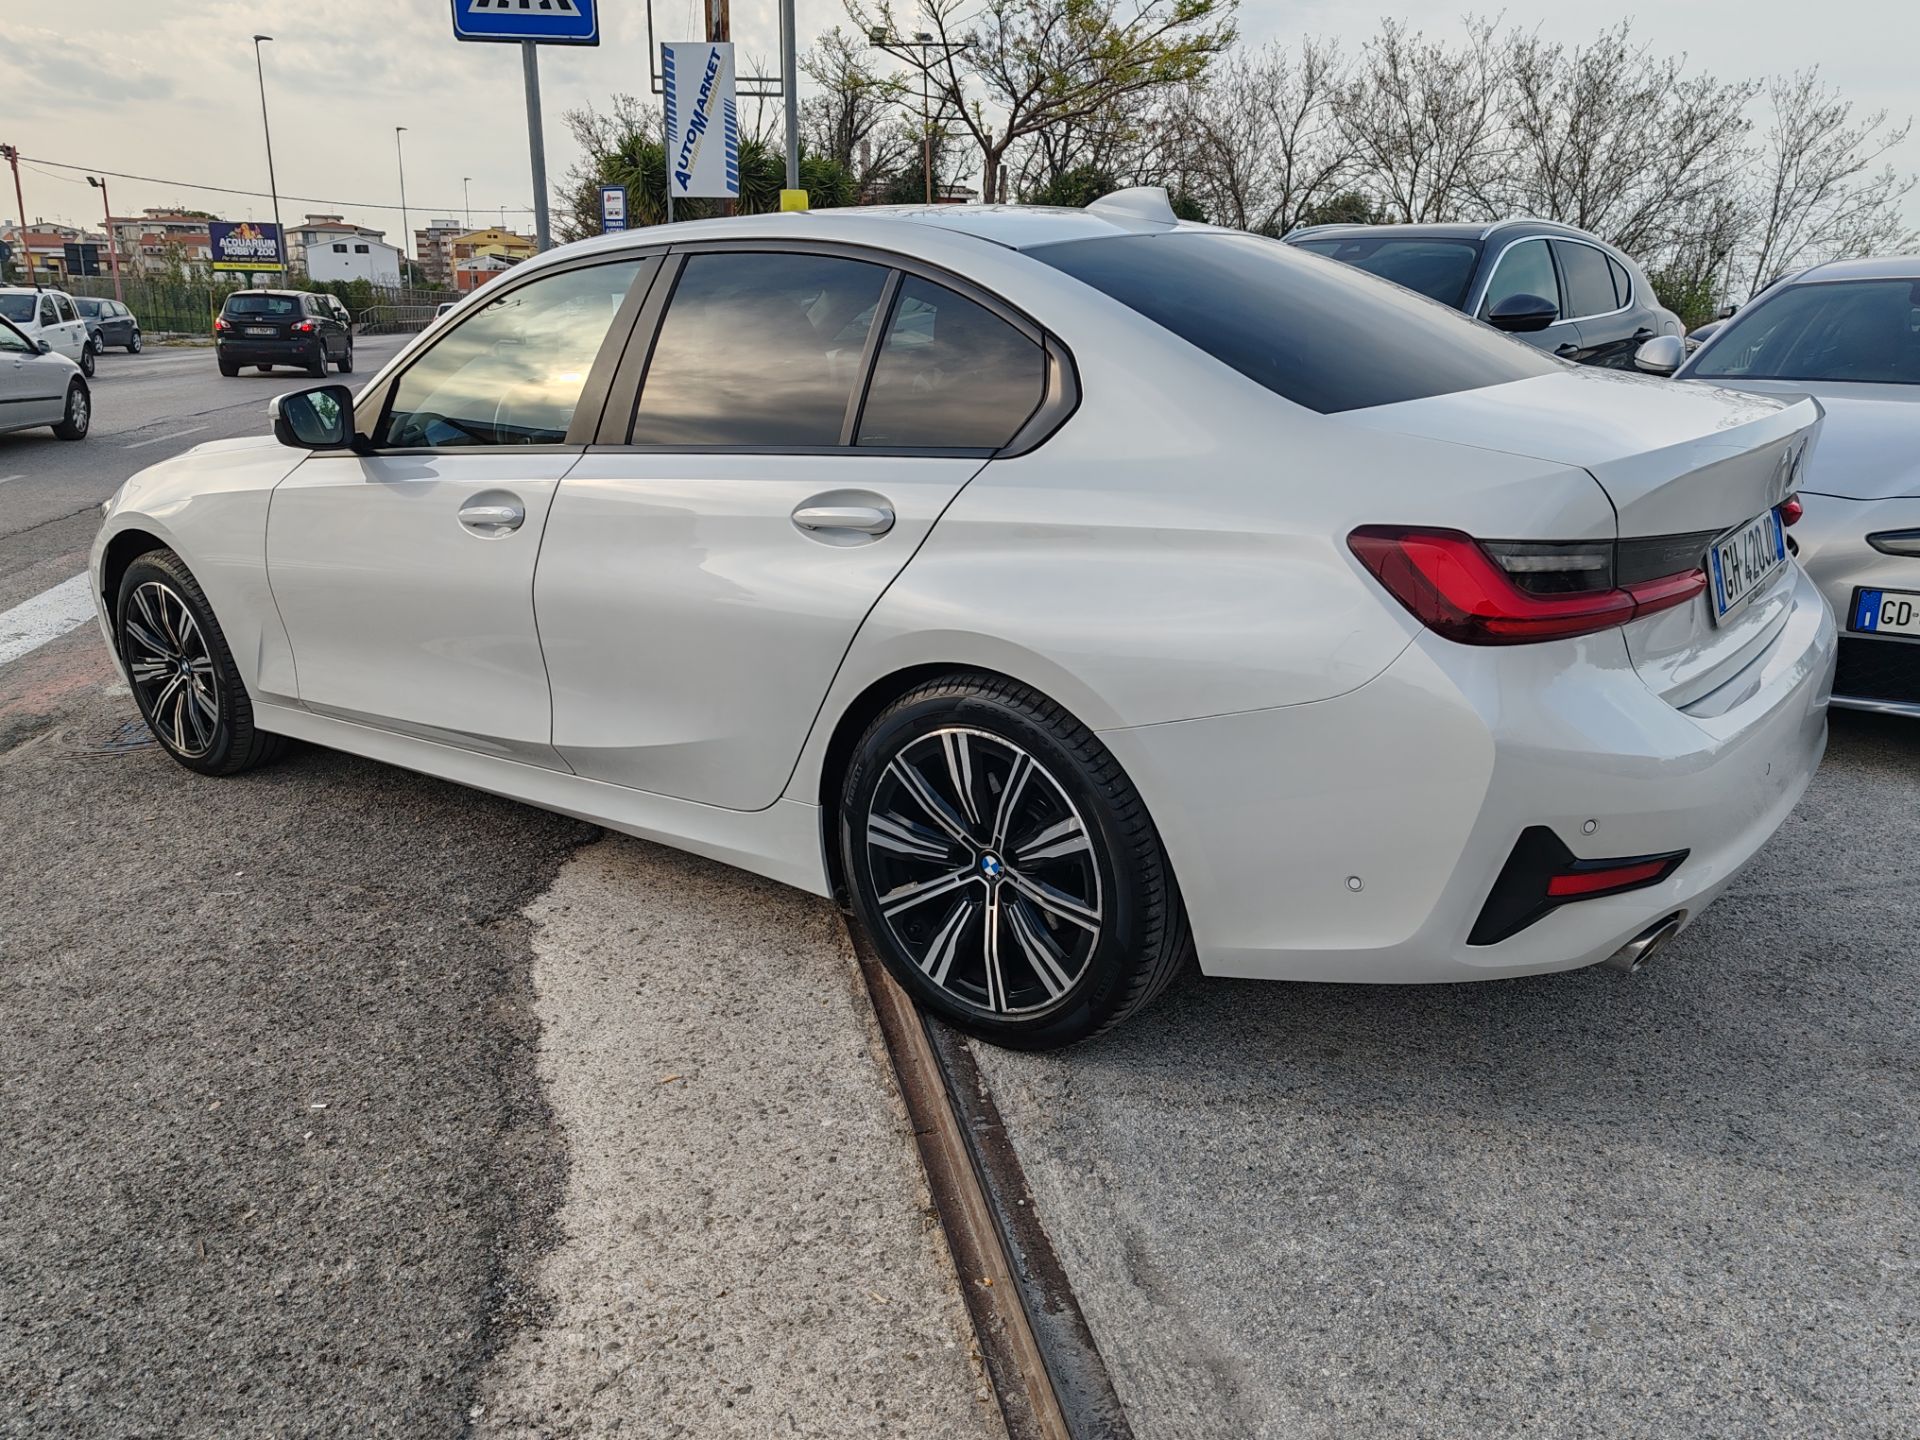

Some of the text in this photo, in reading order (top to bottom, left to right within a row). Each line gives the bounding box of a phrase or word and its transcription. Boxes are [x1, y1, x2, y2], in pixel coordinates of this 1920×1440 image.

[674, 46, 721, 192] AUTOMARKET
[224, 247, 276, 256] HOBBY ZOO
[1722, 542, 1743, 600] GH
[1743, 515, 1777, 585] 420JD
[1881, 600, 1912, 626] GD
